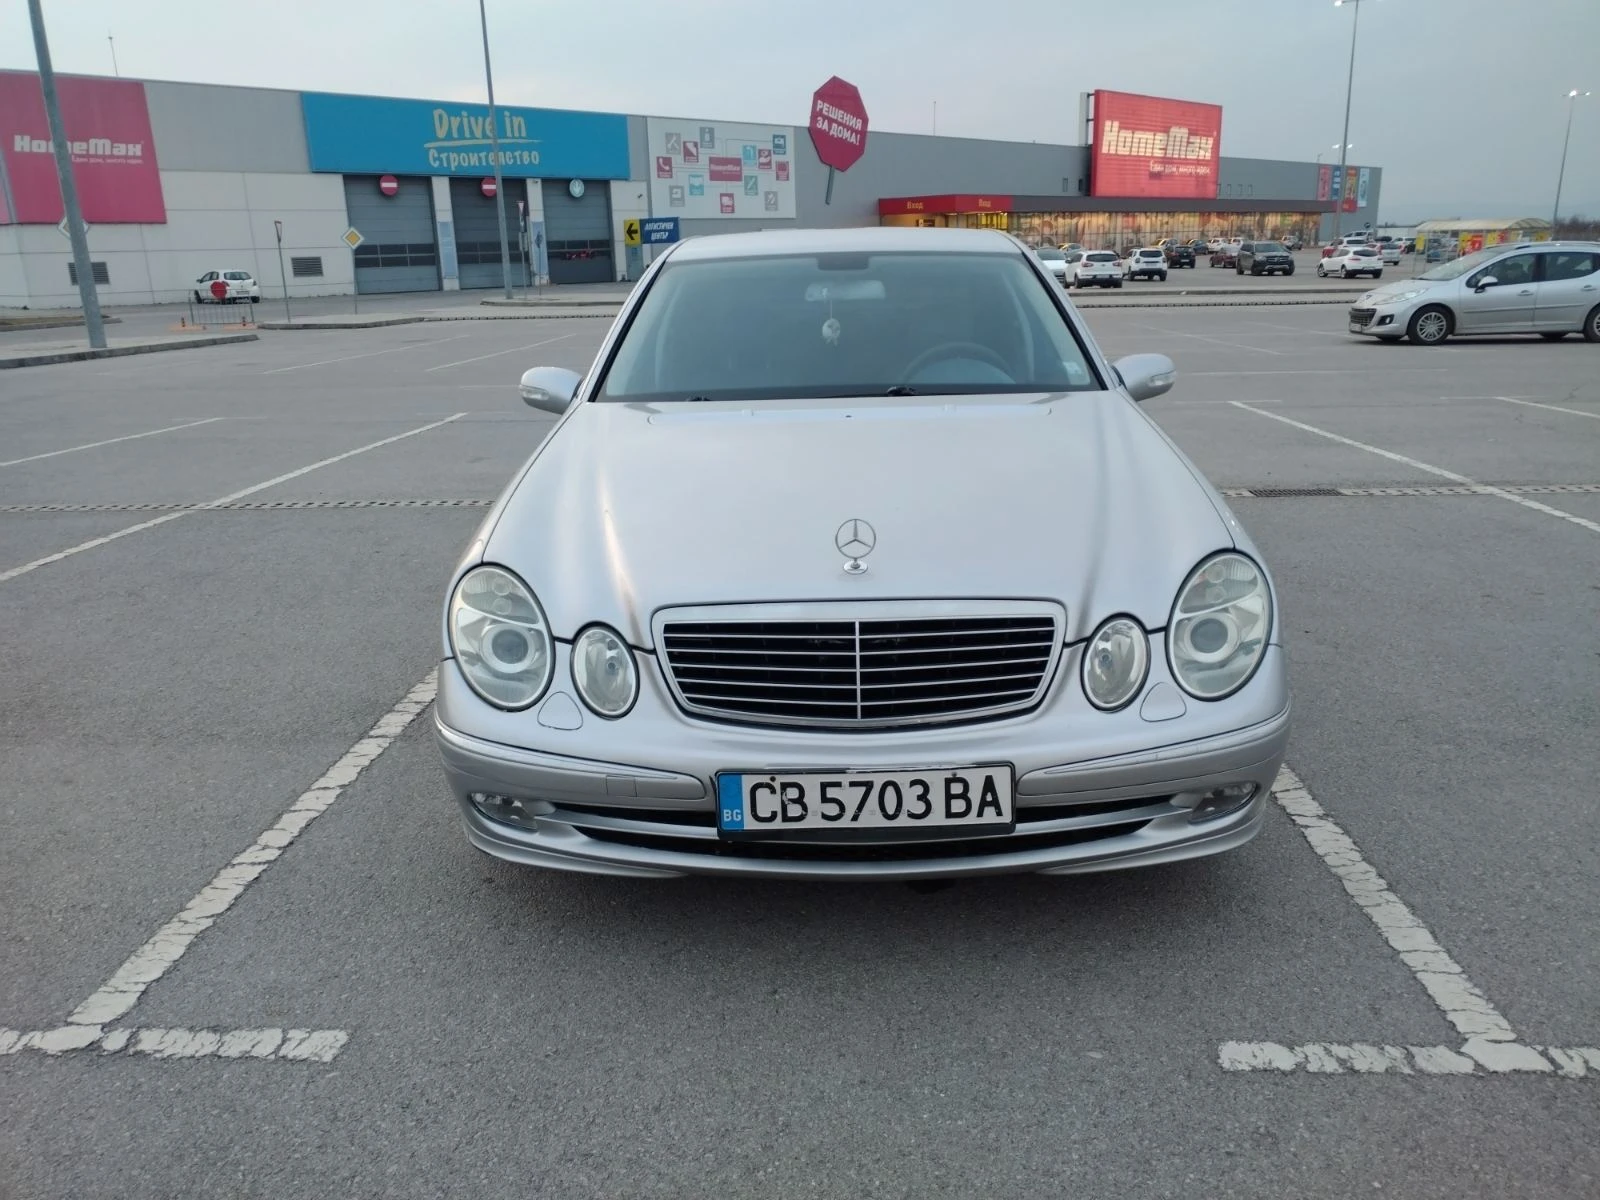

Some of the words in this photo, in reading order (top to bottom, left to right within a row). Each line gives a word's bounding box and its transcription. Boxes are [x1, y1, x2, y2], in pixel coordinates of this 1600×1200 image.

[433, 108, 496, 139] Drive
[504, 110, 527, 138] in
[816, 100, 862, 131] РЕШЕНИЯ
[816, 116, 829, 132] ЗА
[829, 122, 861, 146] ДОМА!
[1101, 119, 1214, 160] HomeMax
[428, 148, 540, 171] Строителство
[723, 809, 741, 821] BG
[749, 781, 808, 823] CB
[820, 779, 932, 821] 5703
[944, 774, 1003, 819] BA
